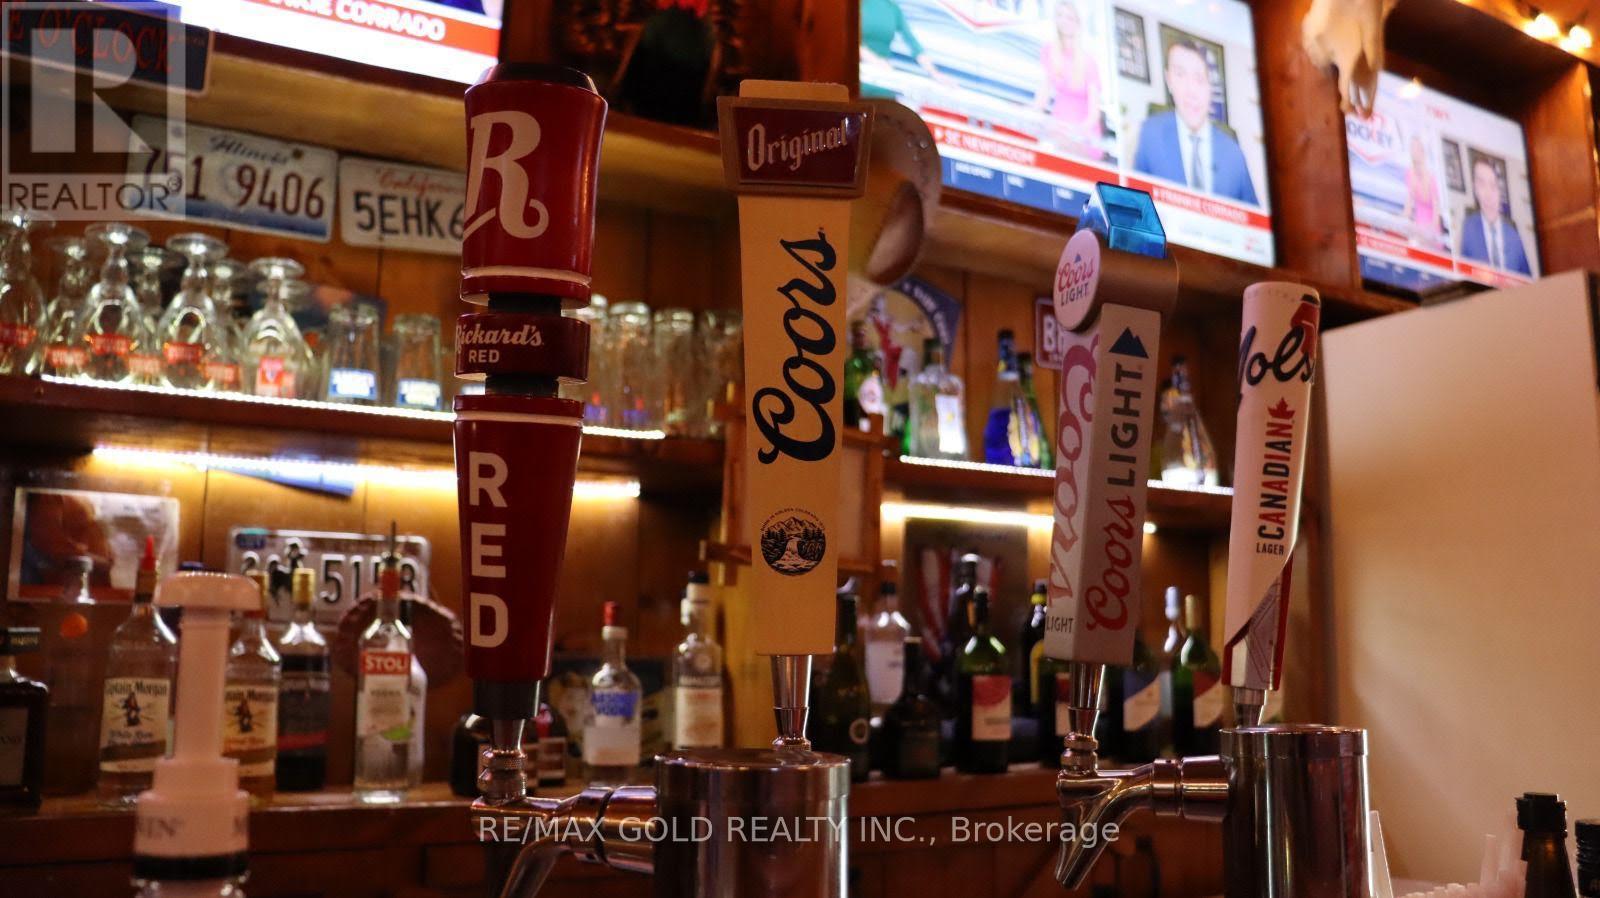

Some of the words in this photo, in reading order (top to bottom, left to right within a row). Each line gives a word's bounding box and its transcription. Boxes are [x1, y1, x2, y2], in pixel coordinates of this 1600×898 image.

[335, 0, 446, 41] CORRADO
[748, 117, 848, 171] Original
[236, 163, 324, 219] 9406
[463, 110, 549, 241] R
[1057, 256, 1095, 293] Coors
[1060, 281, 1090, 307] LIGHT
[455, 324, 543, 354] Rickard's
[468, 349, 500, 364] RED
[752, 227, 837, 464] Coors
[1107, 363, 1143, 487] LIGHT
[1257, 421, 1294, 540] CANADIAN
[469, 451, 509, 648] RED
[1085, 496, 1136, 631] Coors
[1256, 542, 1284, 556] LAGER
[1046, 616, 1073, 633] LIGHT
[365, 655, 408, 672] STOLI
